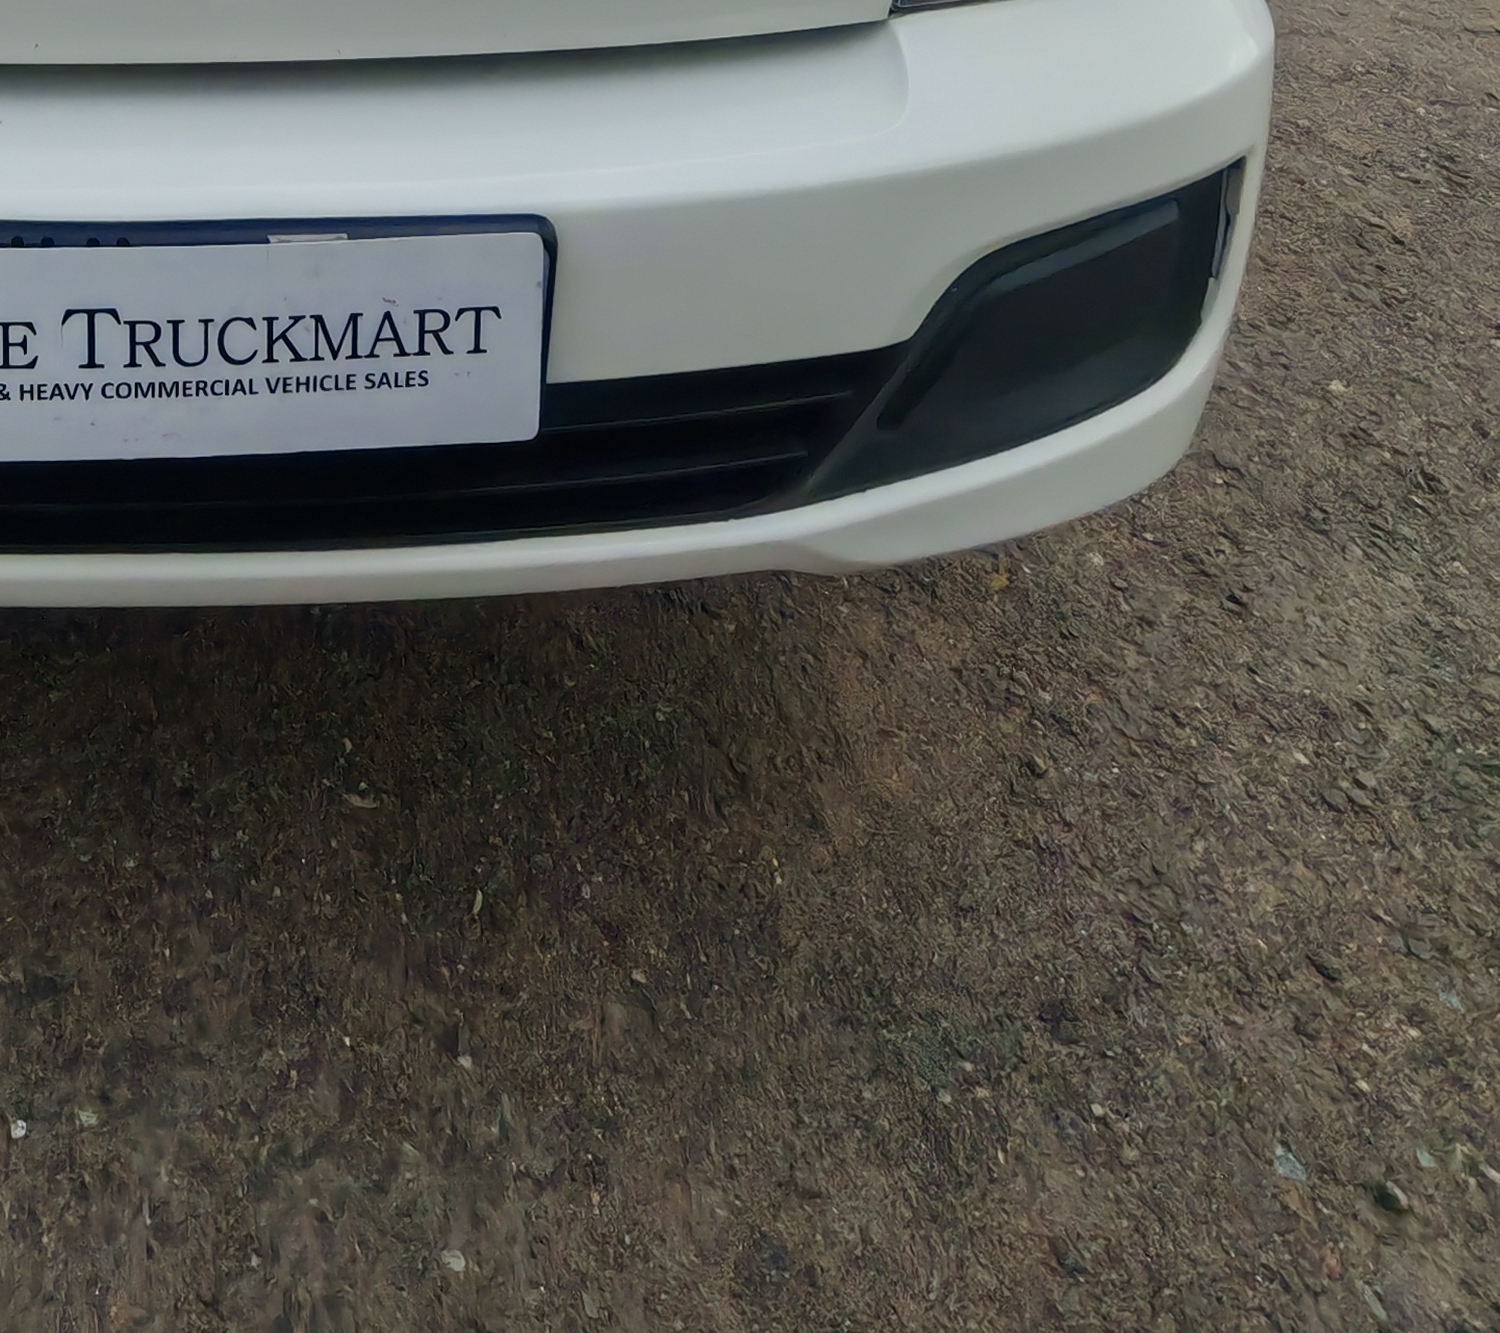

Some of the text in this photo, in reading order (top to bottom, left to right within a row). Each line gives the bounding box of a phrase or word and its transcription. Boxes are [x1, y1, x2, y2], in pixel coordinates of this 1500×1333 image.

[60, 305, 502, 369] TRUCKMART
[18, 381, 94, 401] HEAVY
[100, 376, 260, 400] COMMERCIAL
[265, 372, 357, 395] VEHICLE
[363, 369, 430, 391] SALES
